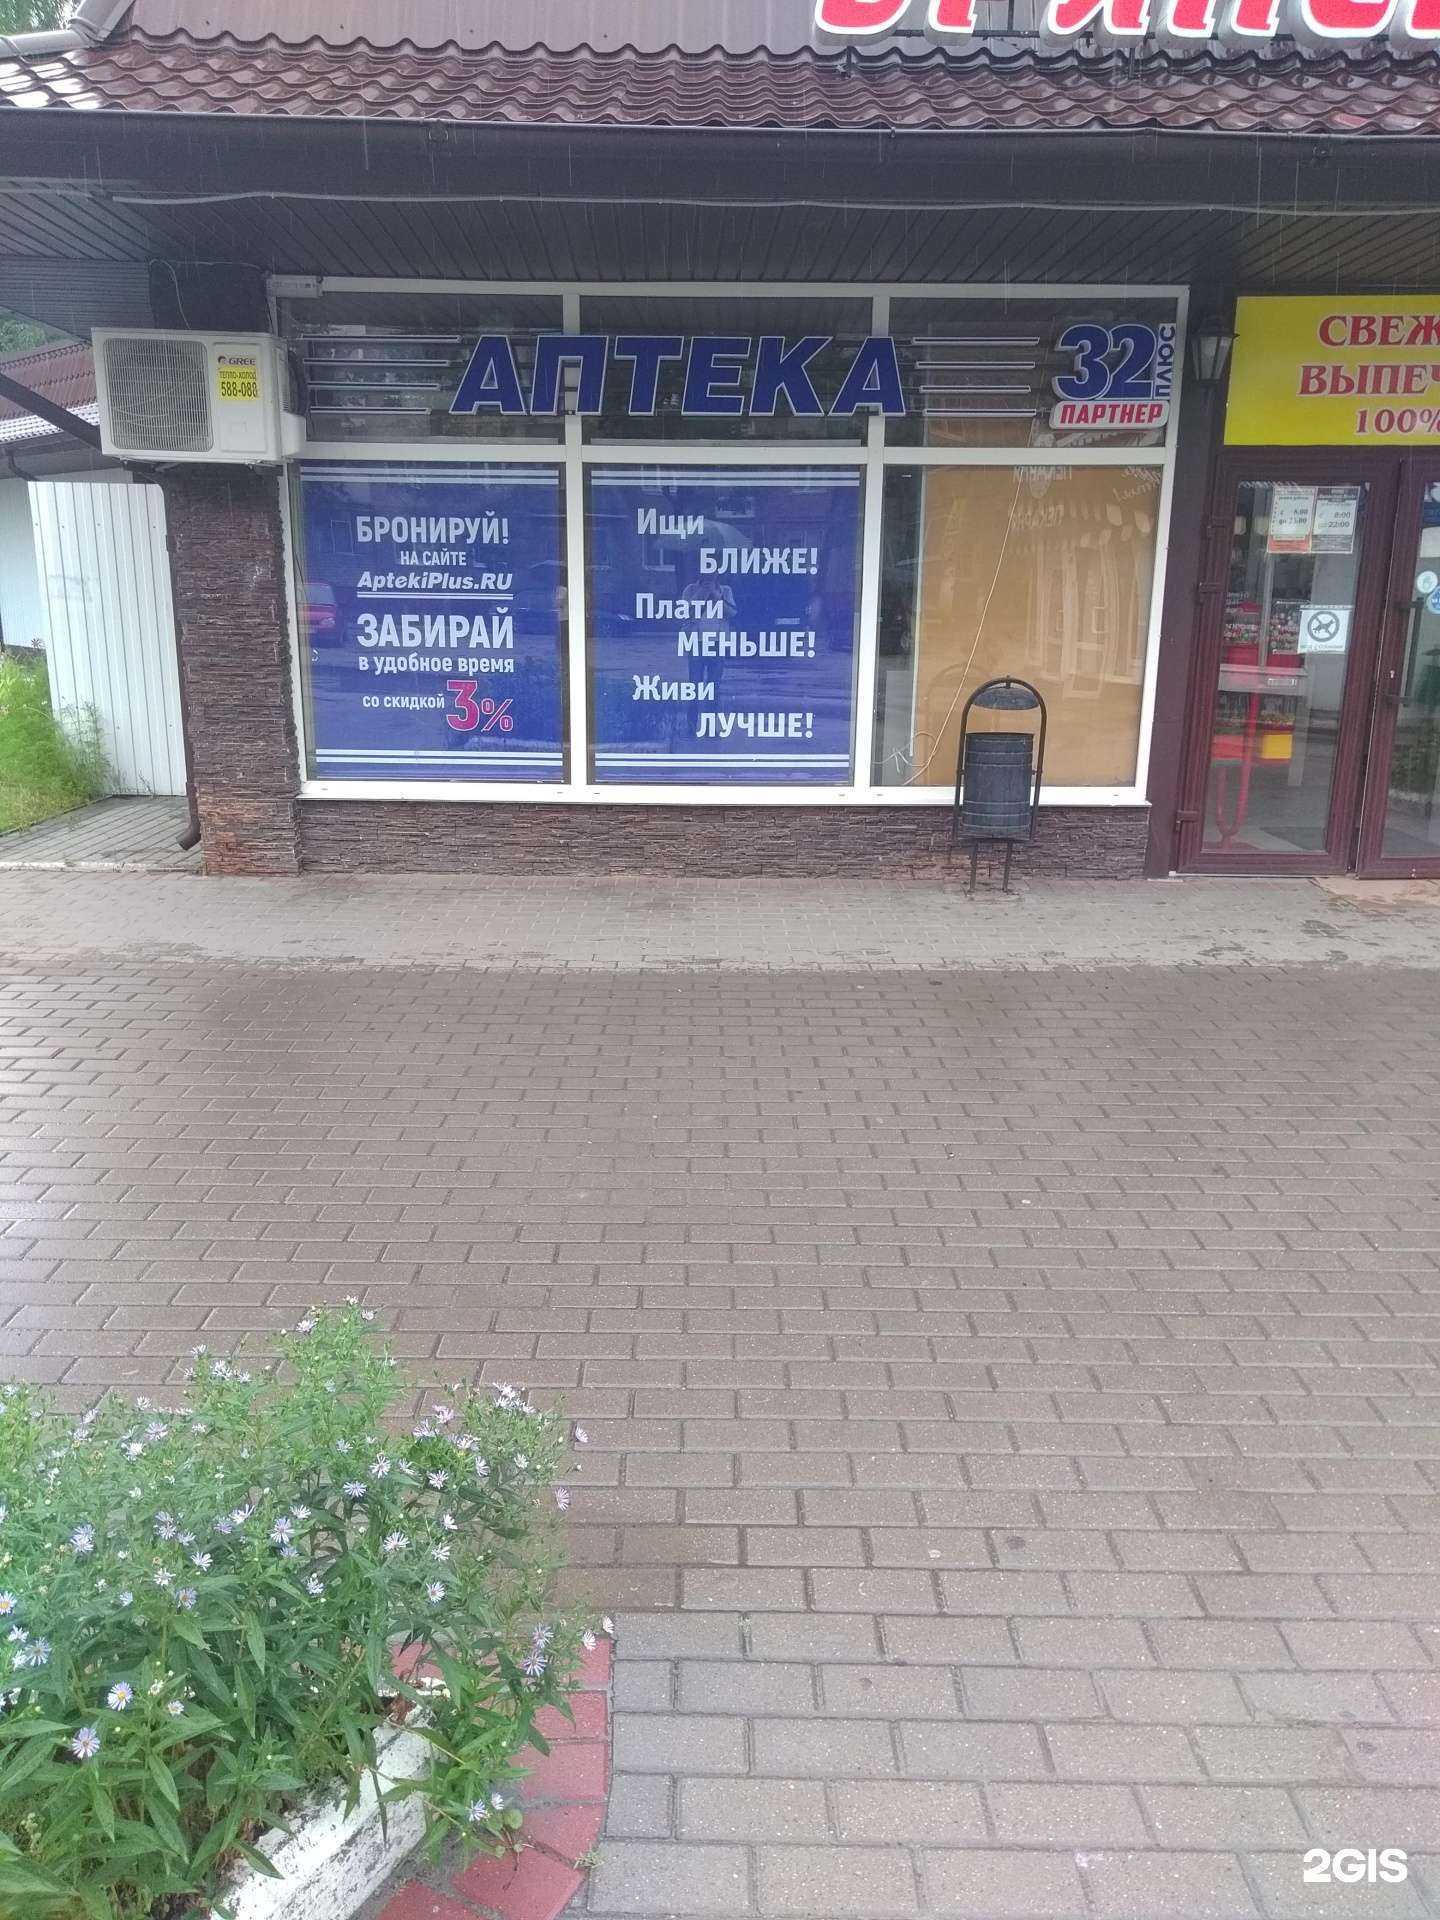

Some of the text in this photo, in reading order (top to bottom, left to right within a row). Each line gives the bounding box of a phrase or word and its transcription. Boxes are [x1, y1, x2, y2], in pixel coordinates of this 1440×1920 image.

[229, 357, 256, 365] GREE
[1053, 323, 1157, 400] 32
[1154, 325, 1176, 397] ПЛЮС
[448, 335, 906, 416] АПТЕКА
[221, 381, 258, 398] 588-088
[1060, 404, 1163, 424] ПАРТНЕР
[356, 510, 509, 545] БРОНИРУЙ!
[637, 508, 704, 539] Ищи
[400, 548, 467, 566] НА САЙТЕ
[700, 547, 818, 575] БЛИЖЕ!
[357, 571, 513, 591] AptekiPlus.RU
[635, 592, 724, 619] Плати
[357, 607, 514, 648] ЗАБИРАЙ
[677, 631, 816, 658] МЕНЬШЕ!
[359, 652, 514, 676] в удобное время
[632, 674, 715, 701] Живи
[362, 679, 514, 732] со скидкой 3%
[696, 712, 814, 738] ЛУЧШЕ!
